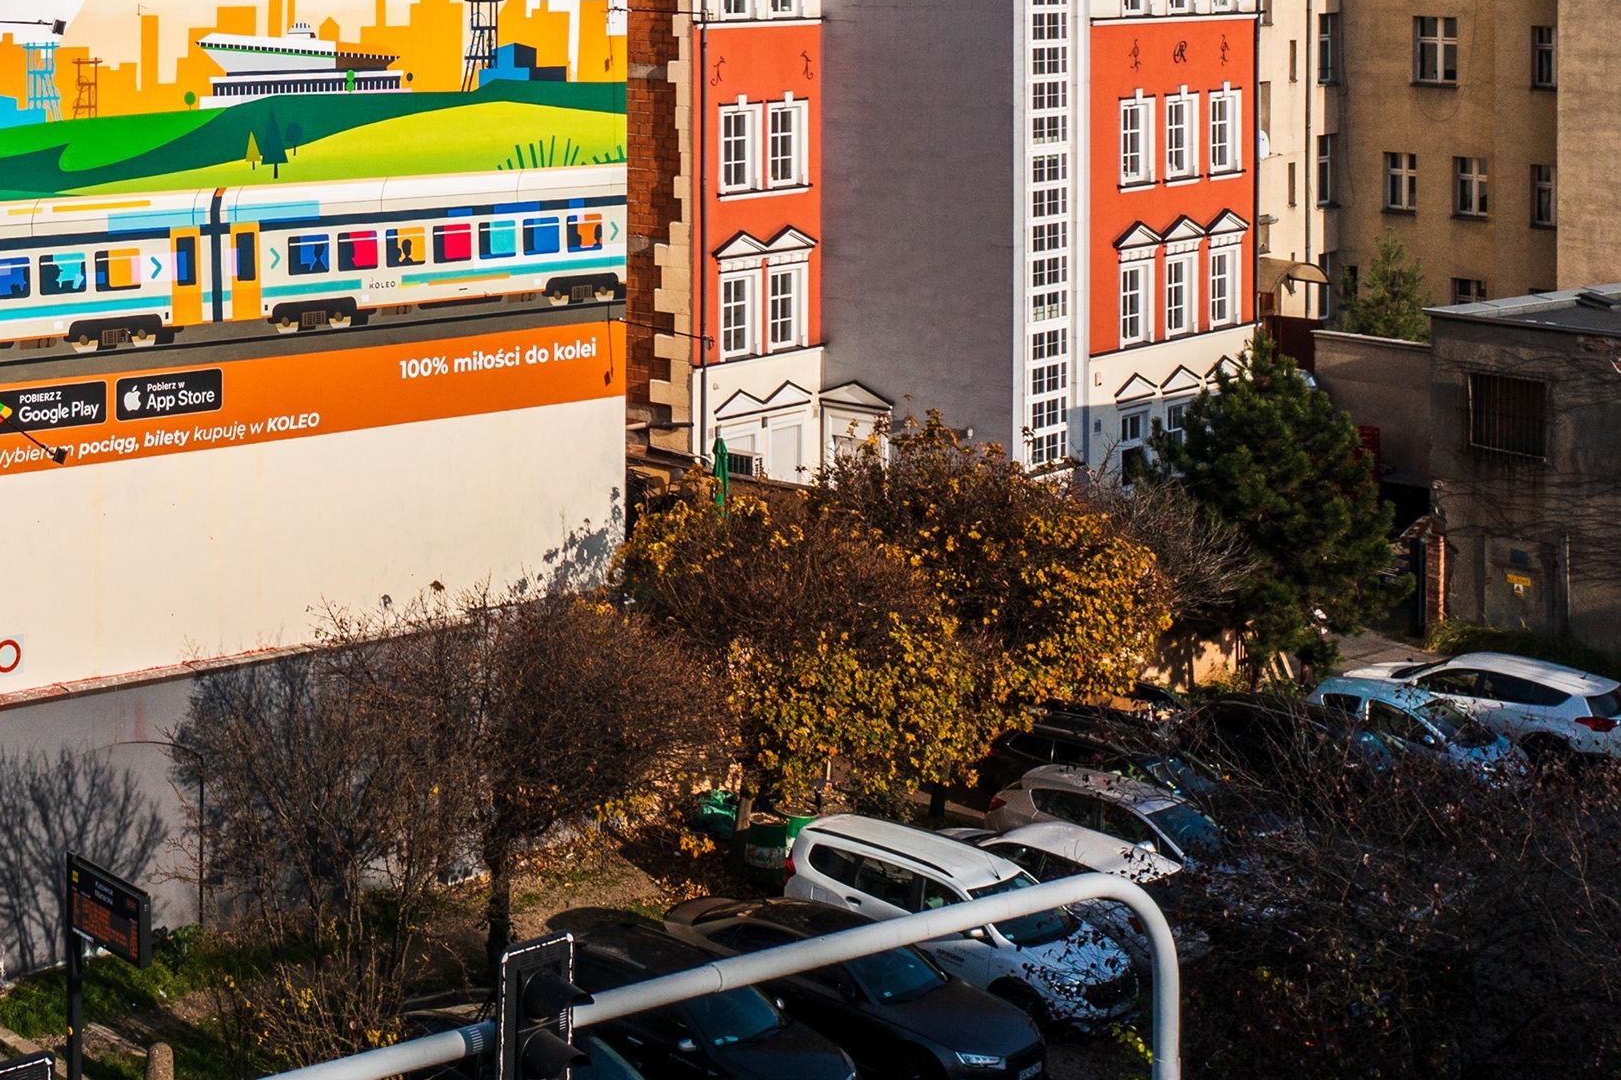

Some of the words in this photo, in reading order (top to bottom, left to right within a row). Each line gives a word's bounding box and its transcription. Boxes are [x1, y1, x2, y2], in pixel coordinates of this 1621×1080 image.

[369, 280, 396, 289] KOLEO
[399, 356, 449, 379] 100%
[453, 346, 520, 373] miłości
[525, 345, 549, 365] do
[553, 337, 597, 361] kolei
[19, 393, 55, 404] POBIERZ
[55, 391, 62, 400] Z
[147, 383, 177, 392] Pobierz
[19, 402, 69, 424] Google
[71, 400, 100, 419] Play
[146, 393, 176, 412] App
[178, 389, 215, 407] Store
[78, 435, 139, 459] pociąg,
[144, 430, 190, 448] bilety
[194, 423, 246, 442] kupuję
[250, 422, 264, 434] w
[266, 412, 320, 433] KOLEO
